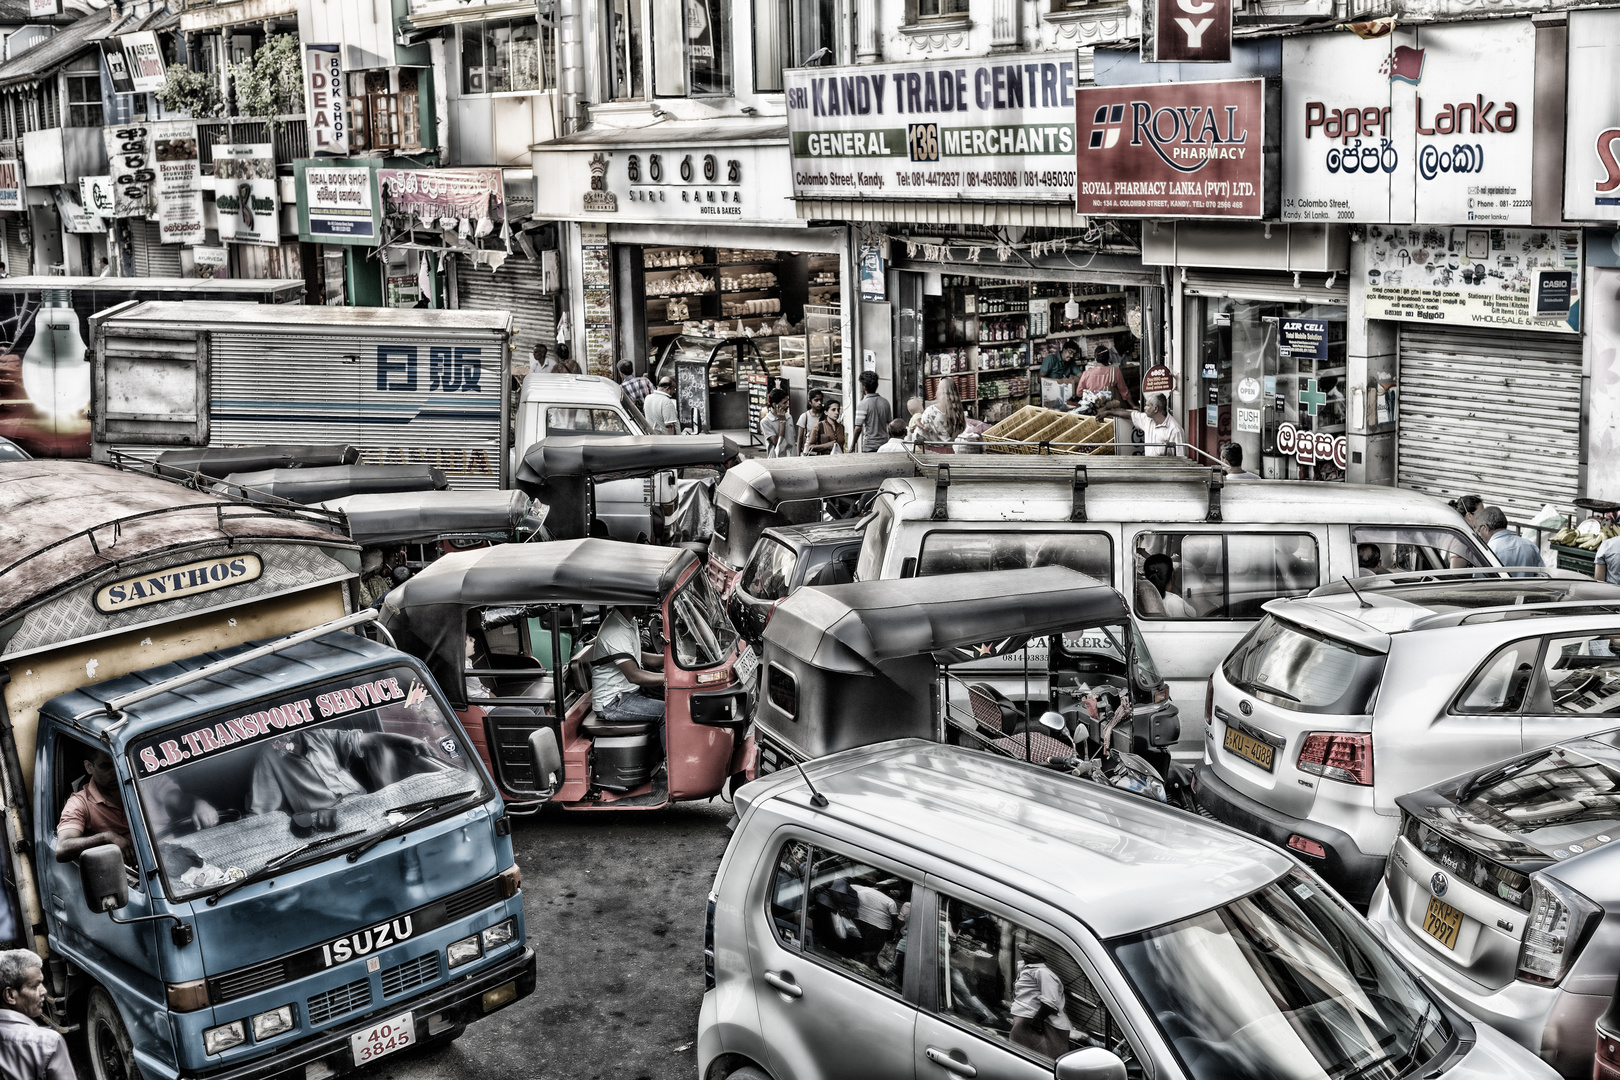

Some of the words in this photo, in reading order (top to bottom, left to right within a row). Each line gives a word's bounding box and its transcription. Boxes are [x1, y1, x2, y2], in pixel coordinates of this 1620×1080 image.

[330, 58, 341, 98] BOOK
[789, 87, 808, 110] SRI
[811, 74, 886, 117] KANDY
[893, 69, 968, 114] TRADE
[975, 62, 1076, 110] CENTRE
[312, 53, 331, 147] IDEAL
[333, 102, 343, 141] SHOP
[1305, 102, 1391, 145] Paper
[1416, 94, 1517, 136] Lanka
[807, 132, 891, 156] GENERAL
[909, 124, 938, 161] 136
[944, 127, 1073, 154] MERCHANTS
[1130, 101, 1248, 173] ROYAL
[1173, 147, 1247, 160] PHARMACY
[1419, 143, 1484, 180] ලංකා
[160, 164, 196, 172] Bowatte
[309, 174, 327, 185] IDEAL
[328, 174, 347, 185] BOOK
[348, 174, 367, 186] SHOP
[796, 172, 828, 186] Colombo
[830, 171, 856, 189] Street,
[858, 172, 885, 190] Kandy.
[896, 171, 911, 187] Tel:
[911, 172, 961, 187] 081-4472937
[966, 172, 1018, 187] 081-4950306
[1082, 181, 1112, 195] ROYAL
[1114, 181, 1167, 196] PHARMACY
[1169, 182, 1201, 196] LANKA
[1204, 180, 1230, 198] (PVT)
[1232, 182, 1256, 196] LTD.
[629, 190, 664, 202] SIRI
[682, 191, 741, 203] RAMYA
[1119, 200, 1146, 208] COLOMBO
[1147, 200, 1169, 209] STREET,
[1298, 199, 1328, 208] Colombo
[1329, 199, 1350, 209] Street,
[428, 203, 459, 218] TRADE
[462, 204, 487, 219] CENT
[722, 207, 742, 215] BAKERS
[1338, 211, 1355, 219] 20000
[1483, 300, 1495, 308] Baby
[1283, 322, 1302, 330] AIR
[1304, 323, 1325, 332] CELL
[1471, 315, 1524, 324] WHOLESALE
[1285, 331, 1295, 339] Total
[1295, 332, 1307, 340] Mobile
[1239, 411, 1258, 423] PUSH
[108, 558, 247, 605] SANTHOS
[1026, 637, 1113, 648] CAERERS
[315, 676, 406, 717] SERVICE
[1438, 902, 1452, 920] KP
[1427, 912, 1454, 944] 7997
[322, 915, 413, 967] ISUZU
[367, 1022, 401, 1045] 40-
[360, 1031, 409, 1061] 3845
